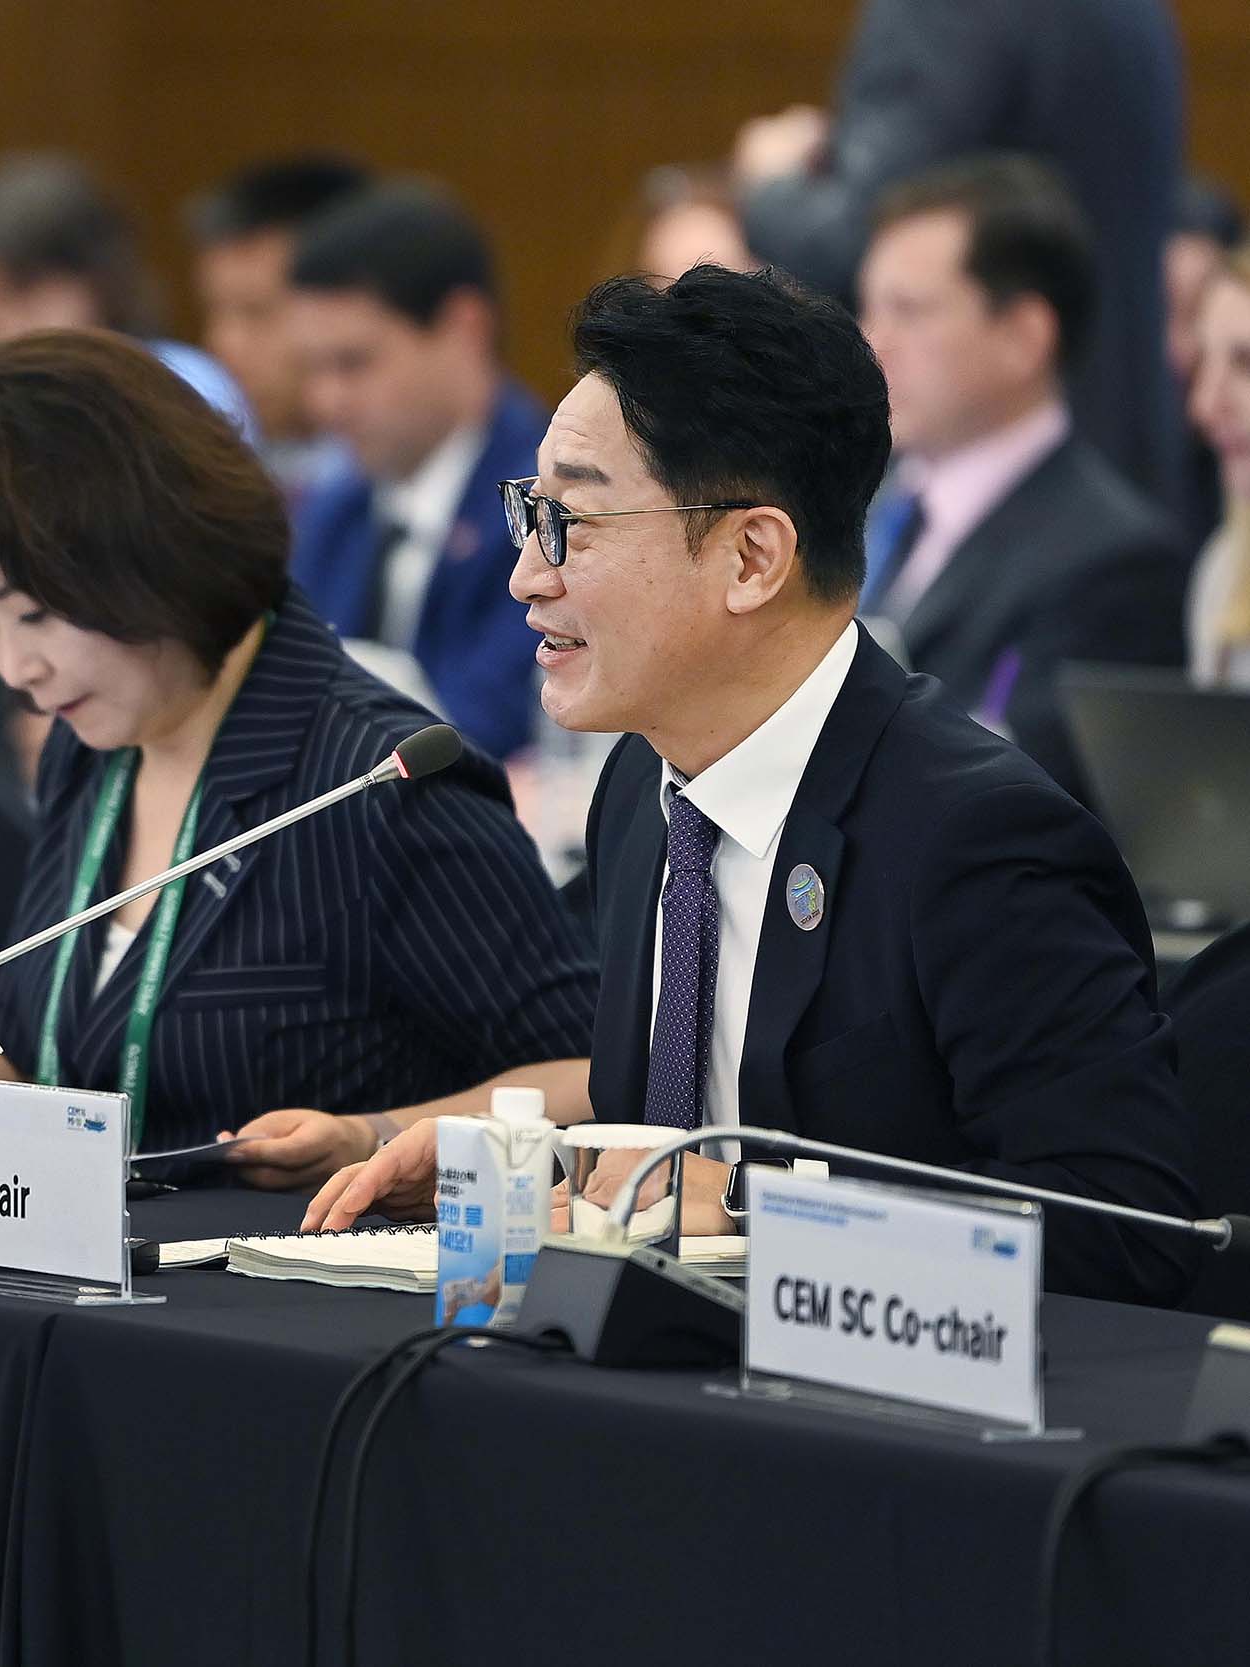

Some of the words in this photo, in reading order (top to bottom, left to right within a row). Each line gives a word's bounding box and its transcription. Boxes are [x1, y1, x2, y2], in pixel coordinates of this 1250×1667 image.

[774, 1274, 832, 1330] CEM
[841, 1287, 875, 1338] SC
[884, 1296, 1008, 1364] Co-chair
